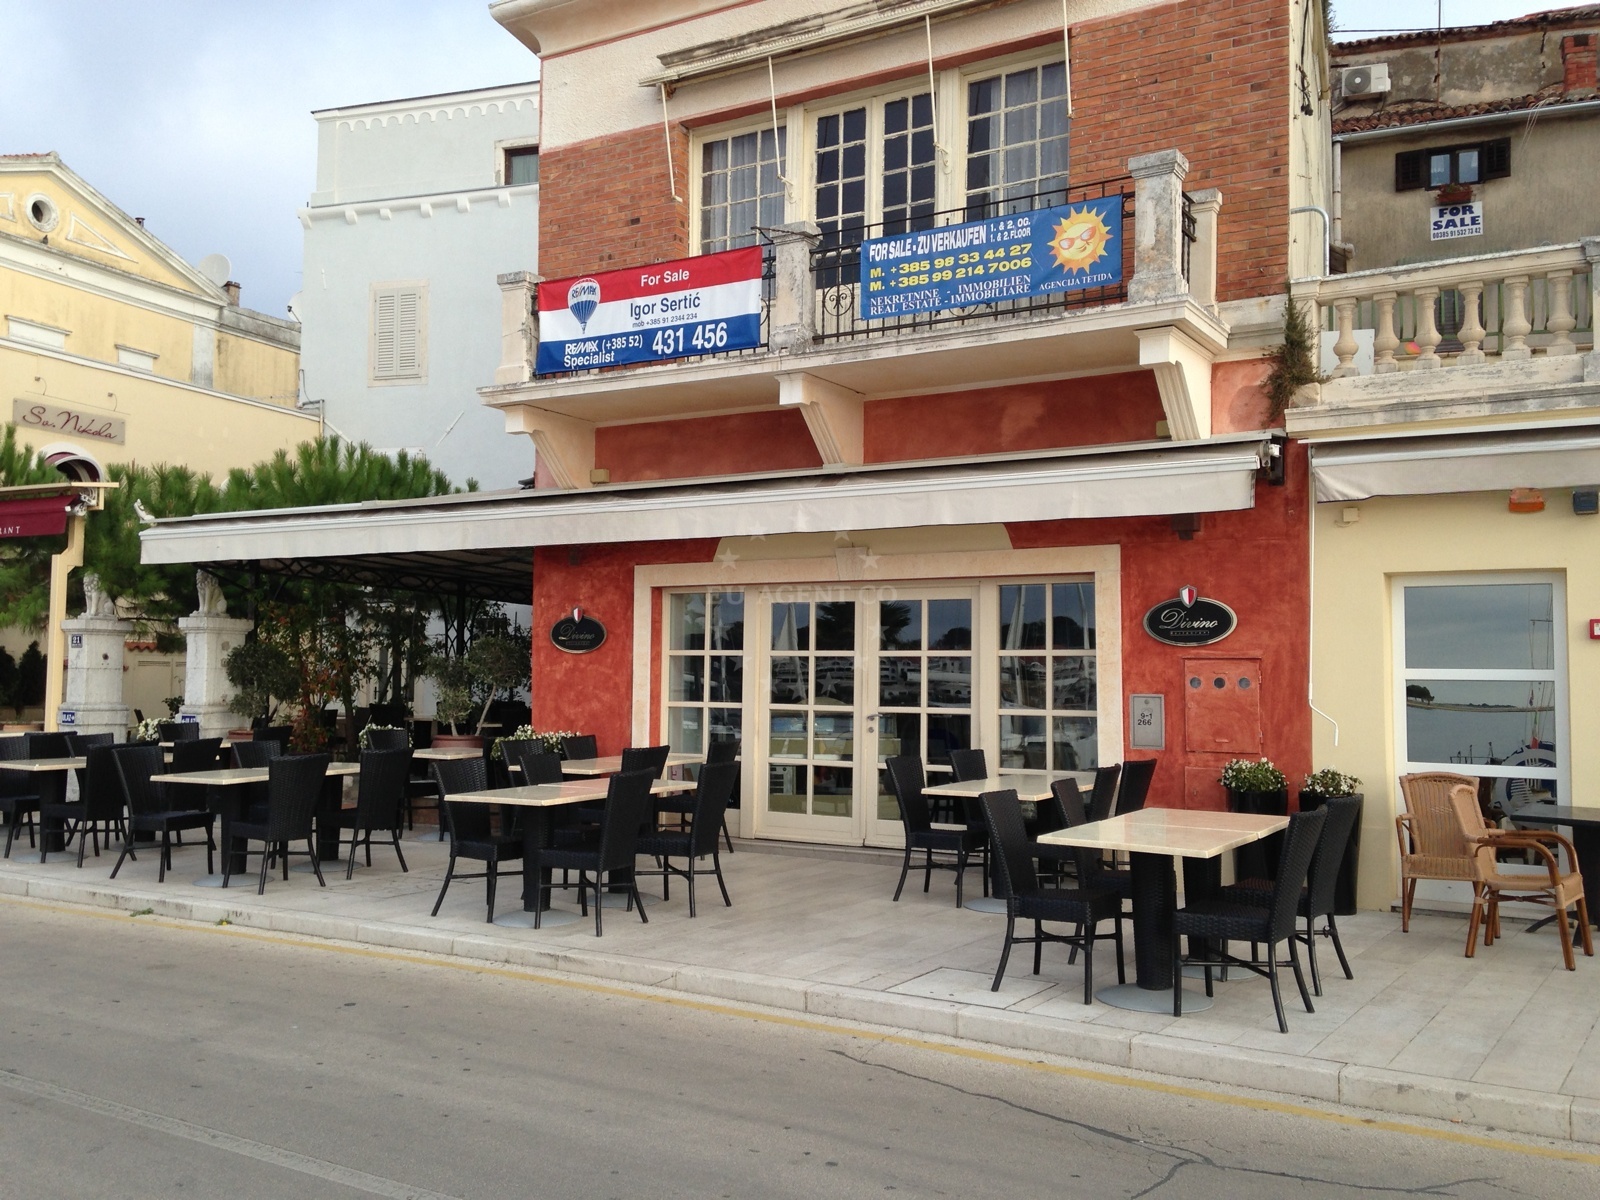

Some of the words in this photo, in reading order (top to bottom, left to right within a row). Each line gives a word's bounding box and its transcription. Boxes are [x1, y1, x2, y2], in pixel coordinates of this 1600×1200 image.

[1439, 205, 1474, 218] FOR
[990, 223, 996, 232] 1.
[998, 221, 1005, 231] &
[1007, 220, 1015, 229] 2.
[1017, 217, 1031, 227] OG.
[1433, 216, 1481, 230] SALE
[869, 243, 888, 262] FOR
[888, 238, 912, 260] SALE
[917, 235, 930, 255] ZU
[931, 225, 987, 253] VERKAUFEN
[990, 233, 996, 242] 1.
[996, 232, 1002, 242] &
[1003, 230, 1010, 240] 2.
[1010, 227, 1031, 239] FLOOR
[1433, 231, 1449, 239] 00385
[1450, 229, 1456, 237] 91
[870, 267, 885, 278] M.
[890, 260, 930, 274] +385
[934, 256, 954, 269] 98
[958, 252, 980, 264] 33
[984, 248, 1005, 260] 44
[1009, 243, 1032, 256] 27
[641, 274, 661, 287] For
[663, 269, 690, 283] Sale
[869, 280, 885, 291] M.
[890, 274, 930, 287] +385
[932, 270, 953, 282] 99
[955, 265, 985, 279] 214
[988, 257, 1032, 273] 7006
[1039, 277, 1080, 291] AGENCIJA
[1082, 272, 1113, 285] TETIDA
[870, 288, 940, 307] NEKRETNINE
[958, 274, 1031, 294] IMMOBILIEN
[870, 303, 898, 315] REAL
[902, 297, 942, 311] ESTATE
[951, 284, 1031, 304] IMMOBILIARE
[630, 302, 656, 320] Igor
[660, 292, 700, 313] Sertić
[632, 320, 644, 328] mob
[646, 318, 661, 326] +385
[670, 315, 685, 323] 2344
[565, 339, 599, 355] RE/MAX
[602, 337, 627, 351] (+385
[628, 334, 643, 348] 52)
[652, 327, 684, 355] 431
[692, 322, 727, 350] 456
[564, 351, 615, 369] Specialist
[22, 405, 56, 428] Sv.
[57, 411, 117, 439] Nikola
[1159, 608, 1219, 629] Divino
[1140, 712, 1153, 720] 9-1
